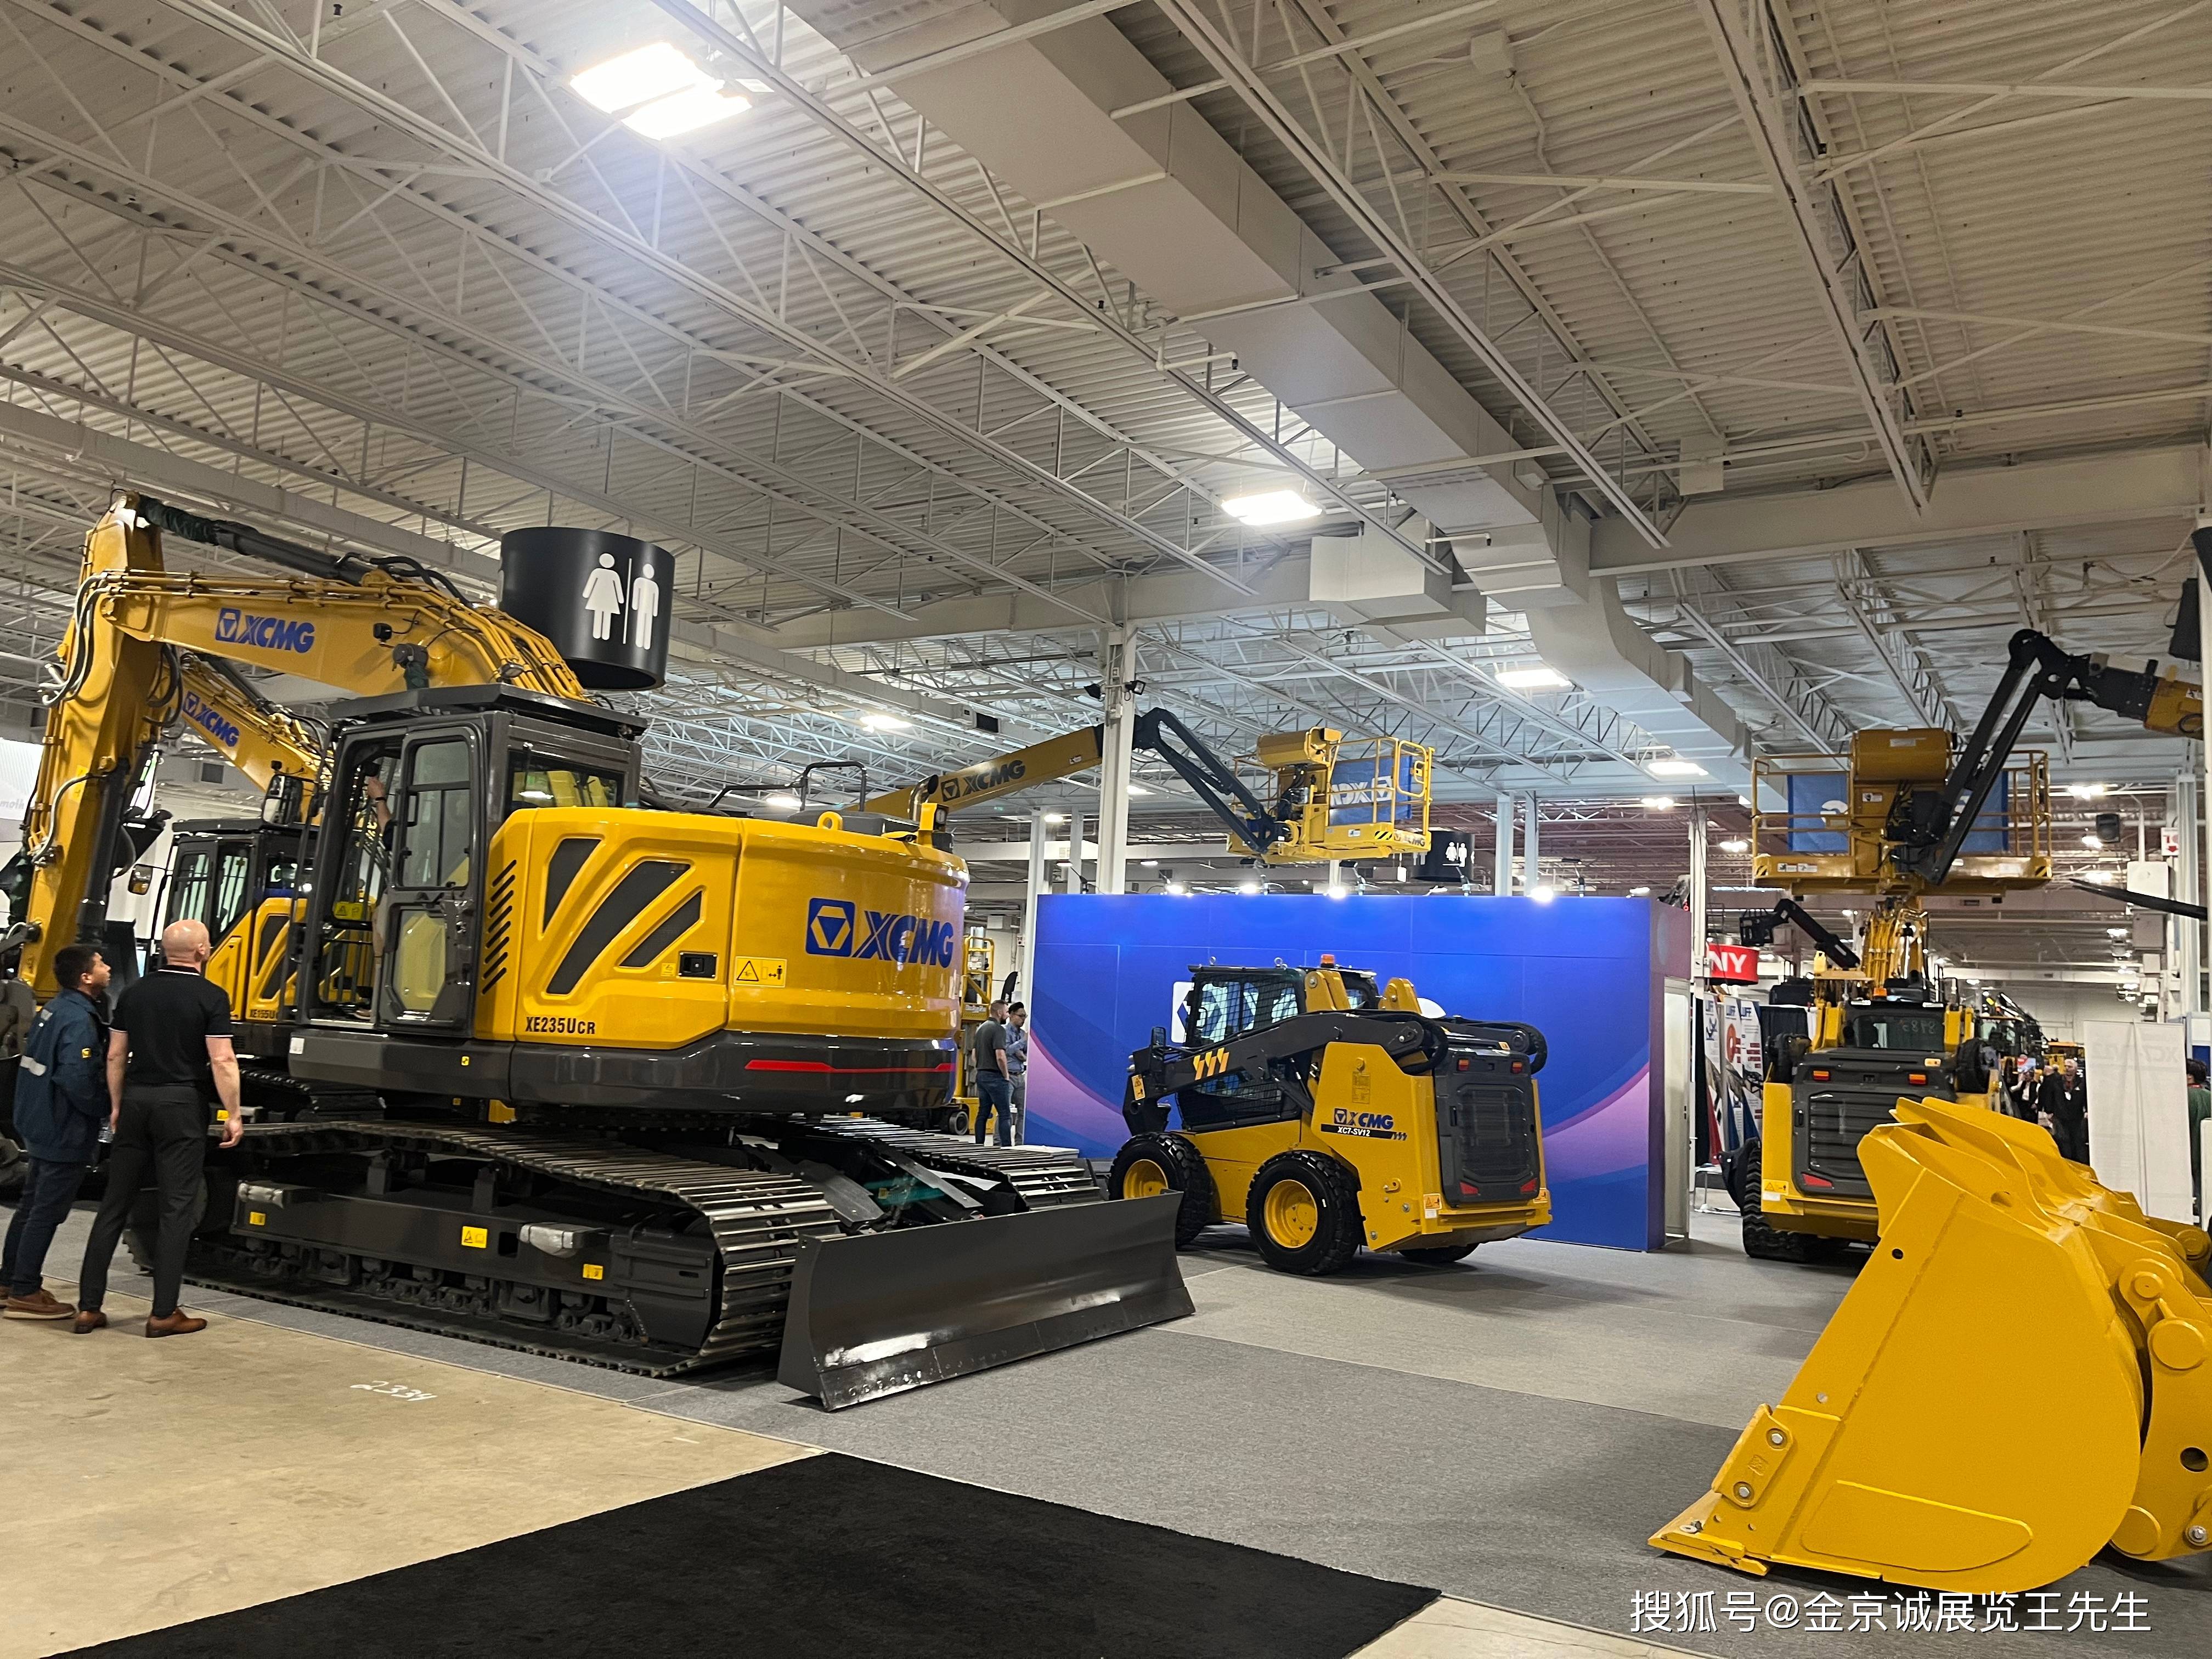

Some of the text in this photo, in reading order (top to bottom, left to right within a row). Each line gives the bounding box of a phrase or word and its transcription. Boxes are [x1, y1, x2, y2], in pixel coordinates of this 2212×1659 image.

[238, 615, 315, 653] XCMG
[194, 703, 240, 747] XCMG
[963, 760, 1025, 796] XCMG
[851, 910, 953, 968] XCMG
[525, 1017, 595, 1034] XE235UCR
[1337, 1126, 1370, 1137] XC7-SV12
[1347, 1112, 1394, 1130] XCMG
